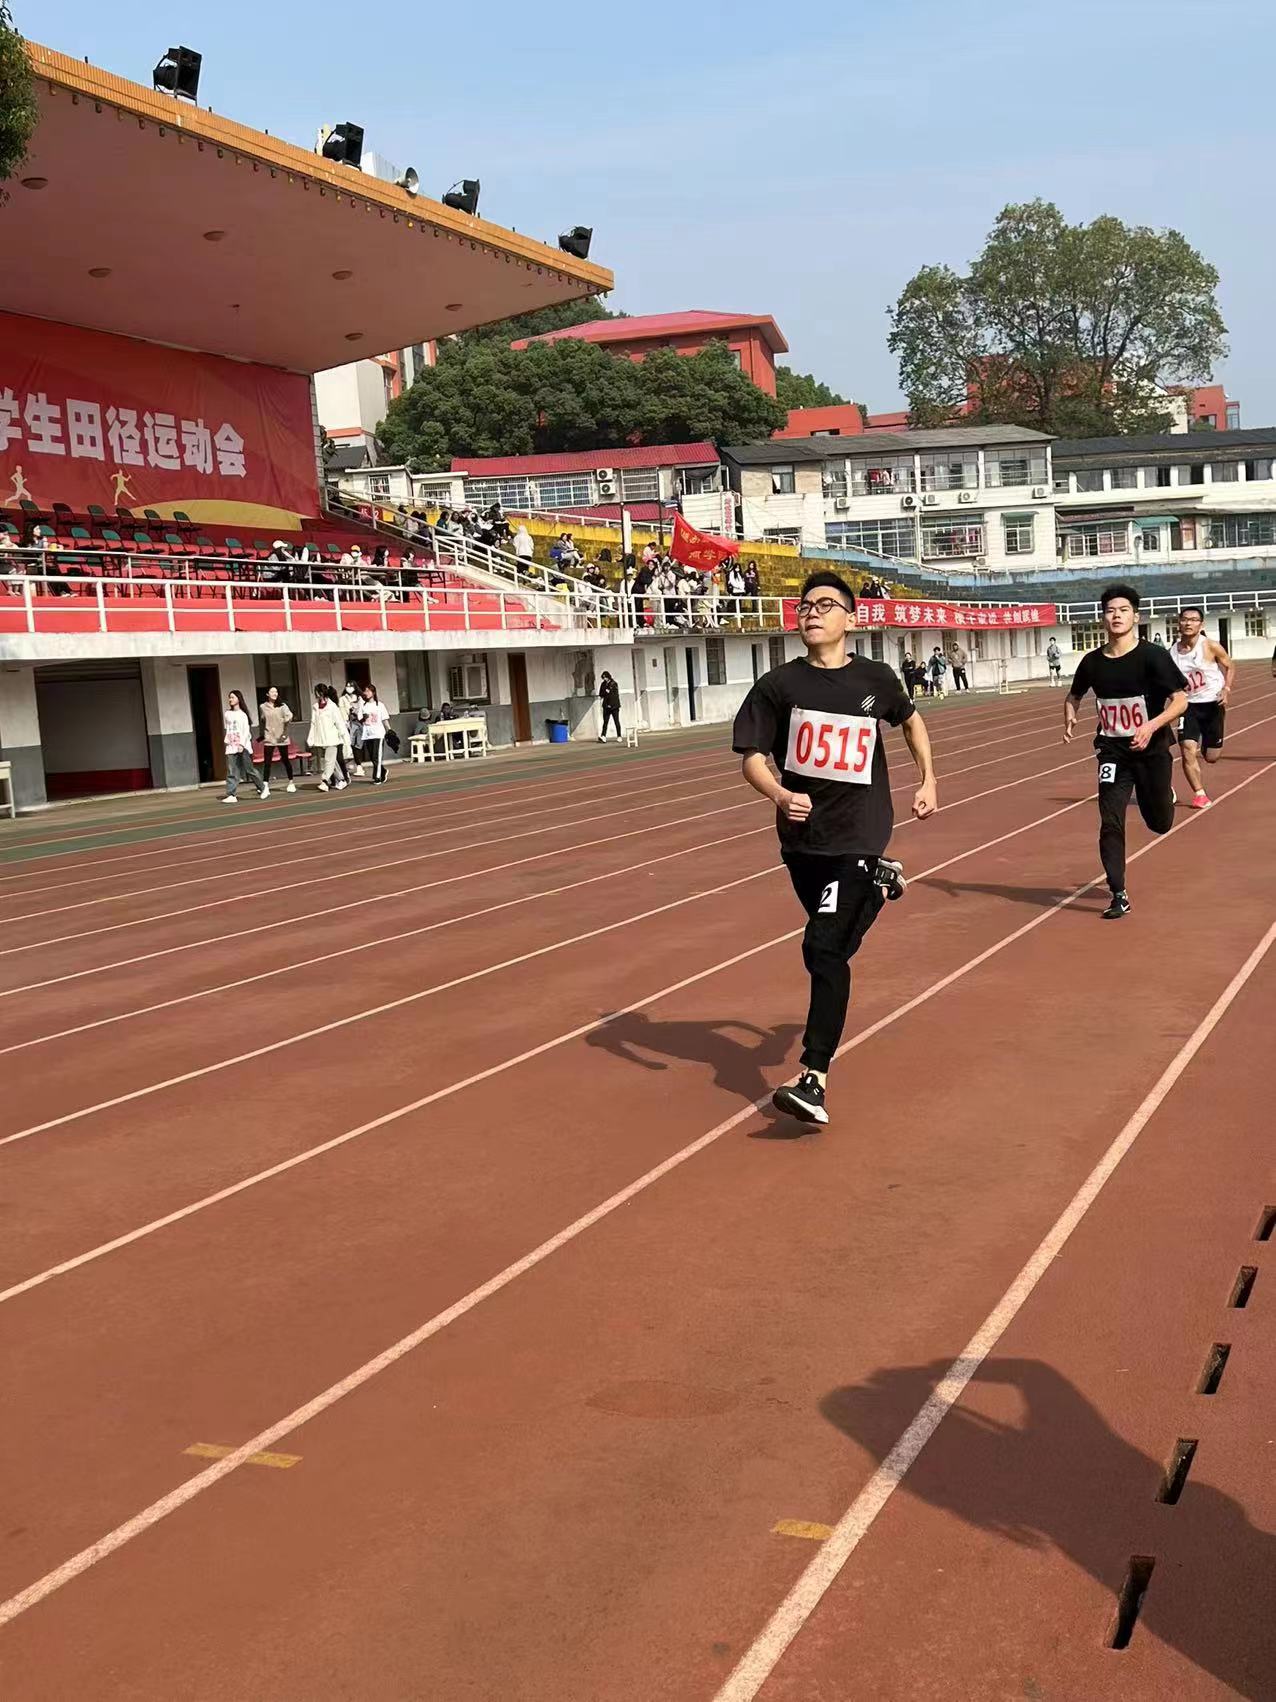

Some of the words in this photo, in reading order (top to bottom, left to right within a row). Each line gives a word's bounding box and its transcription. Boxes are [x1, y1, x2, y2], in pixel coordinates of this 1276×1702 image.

[856, 603, 886, 624] 自我
[894, 604, 948, 624] 筑梦未来
[1100, 703, 1143, 731] 0706
[796, 721, 871, 772] 0515
[1101, 765, 1112, 779] 8
[820, 886, 832, 908] 2
